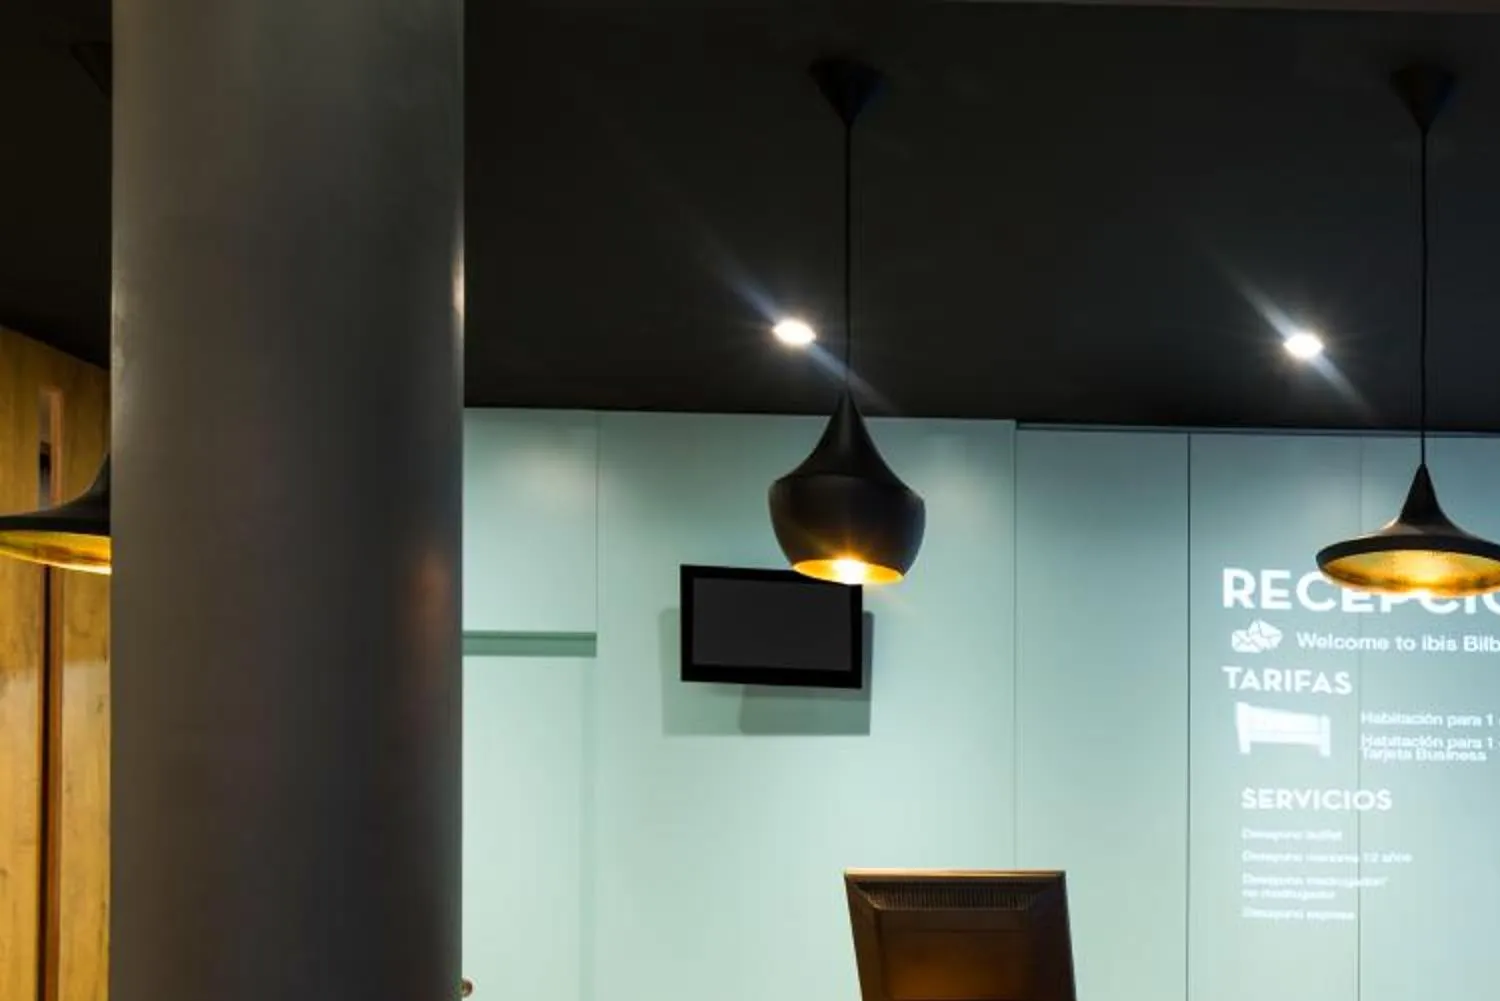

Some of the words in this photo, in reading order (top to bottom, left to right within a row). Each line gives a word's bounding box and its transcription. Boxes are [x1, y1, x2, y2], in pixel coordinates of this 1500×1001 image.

[1297, 631, 1390, 651] Welcome
[1395, 636, 1416, 651] to
[1422, 634, 1457, 652] ibis
[1222, 666, 1352, 695] TARIFAS
[1485, 713, 1493, 727] 1
[1241, 789, 1393, 811] SERVICIOS
